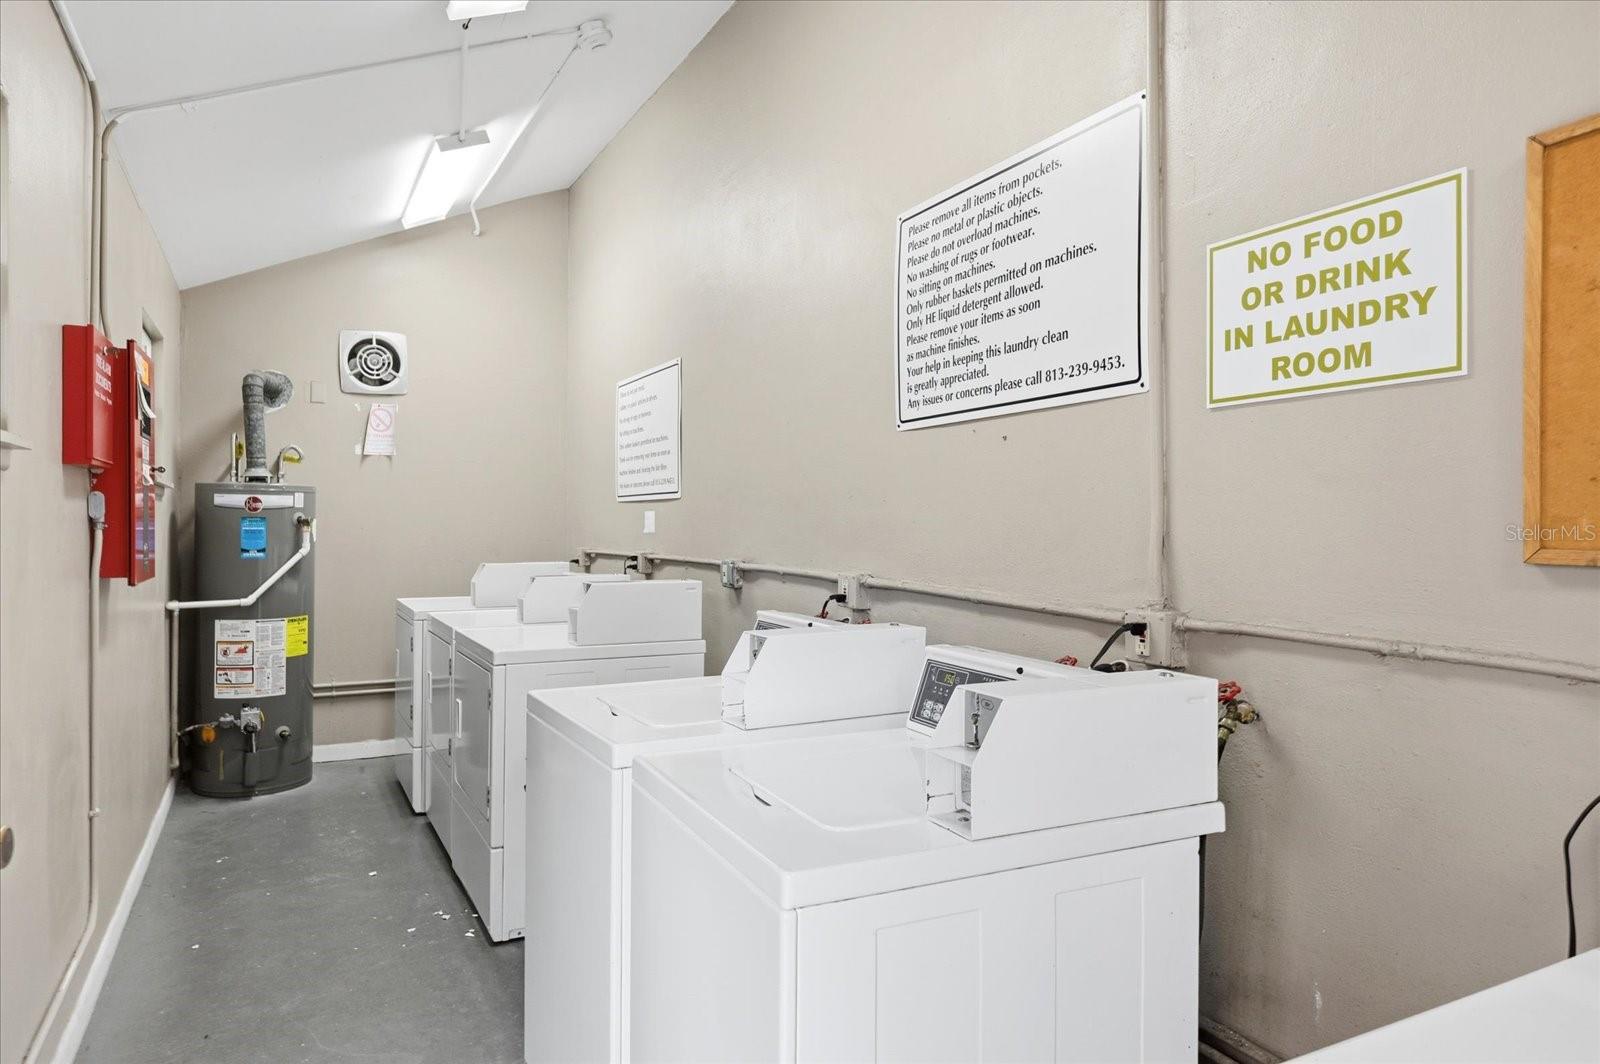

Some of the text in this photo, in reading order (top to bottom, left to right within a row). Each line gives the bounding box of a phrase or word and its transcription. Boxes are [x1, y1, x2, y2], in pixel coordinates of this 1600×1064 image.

[908, 160, 1062, 238] Please remove all items from pockets.
[908, 187, 1042, 253] Please no metal or plastic objects.
[906, 227, 1034, 284] No washing of rugs or footwear.
[908, 206, 1040, 268] Please do not overload machines.
[1248, 210, 1403, 274] NO FOOD
[906, 242, 1097, 315] Only rubber baskets permitted on machines.
[906, 261, 996, 300] No sitting on machines.
[906, 276, 1044, 330] Only HE liquid detergent allowed.
[1241, 248, 1412, 311] OR DRINK
[906, 300, 1040, 346] Please remove your items as soon
[1224, 286, 1438, 352] IN LAUNDRY
[906, 335, 980, 362] as machine finishes.
[907, 330, 1068, 378] Your help in keeping this laundry clean
[1272, 341, 1372, 381] ROOM
[907, 365, 989, 394] is greatly appreciated.
[908, 355, 1124, 410] Any issues or concerns please call 813-239-9453.
